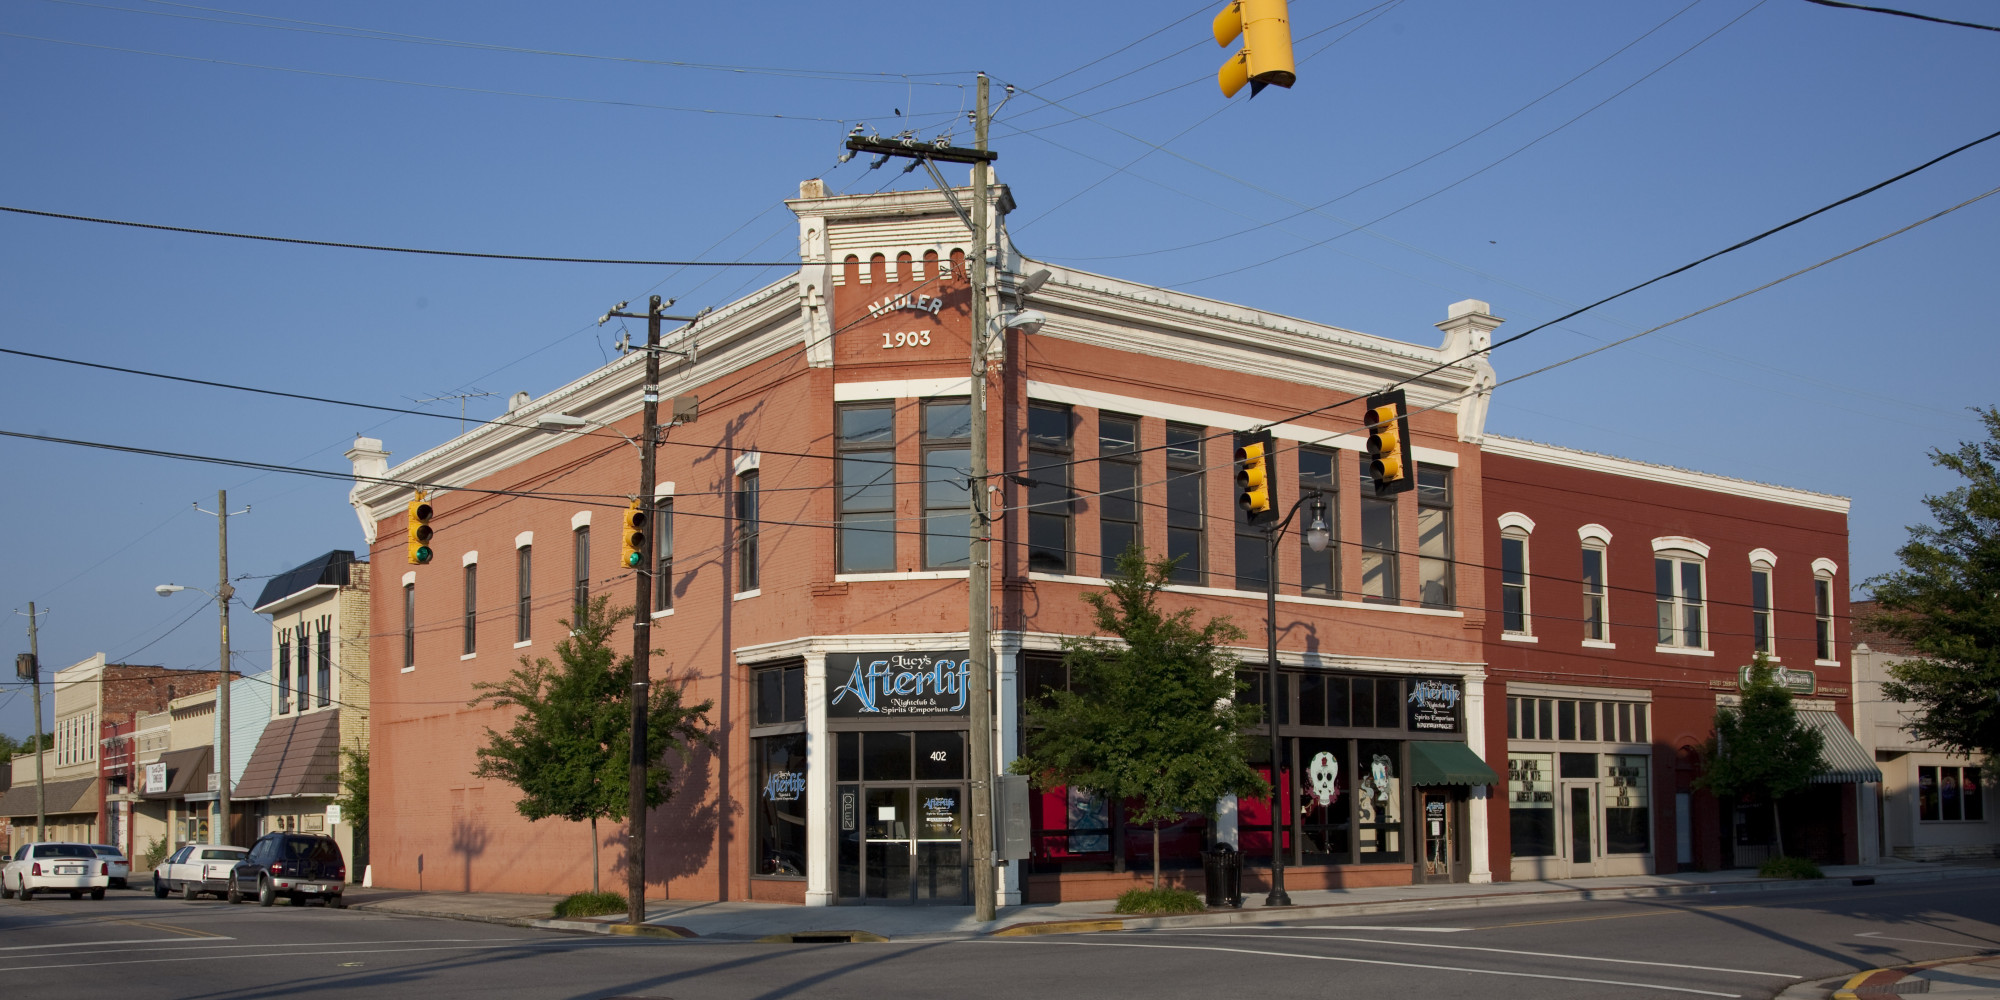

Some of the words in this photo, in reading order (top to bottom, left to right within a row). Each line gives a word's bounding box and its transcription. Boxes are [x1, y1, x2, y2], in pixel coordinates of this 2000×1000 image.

[867, 293, 943, 319] NADLER
[882, 330, 931, 349] 1903
[891, 654, 932, 670] Lucy's
[832, 656, 971, 713] Afterlif
[1408, 679, 1461, 709] Afterlife
[881, 706, 907, 715] Spirits
[908, 706, 949, 715] Emporium
[890, 698, 928, 708] Nightclub
[929, 698, 937, 706] &
[930, 751, 947, 762] 402
[763, 772, 806, 801] Afterlife
[844, 795, 853, 828] OPEN
